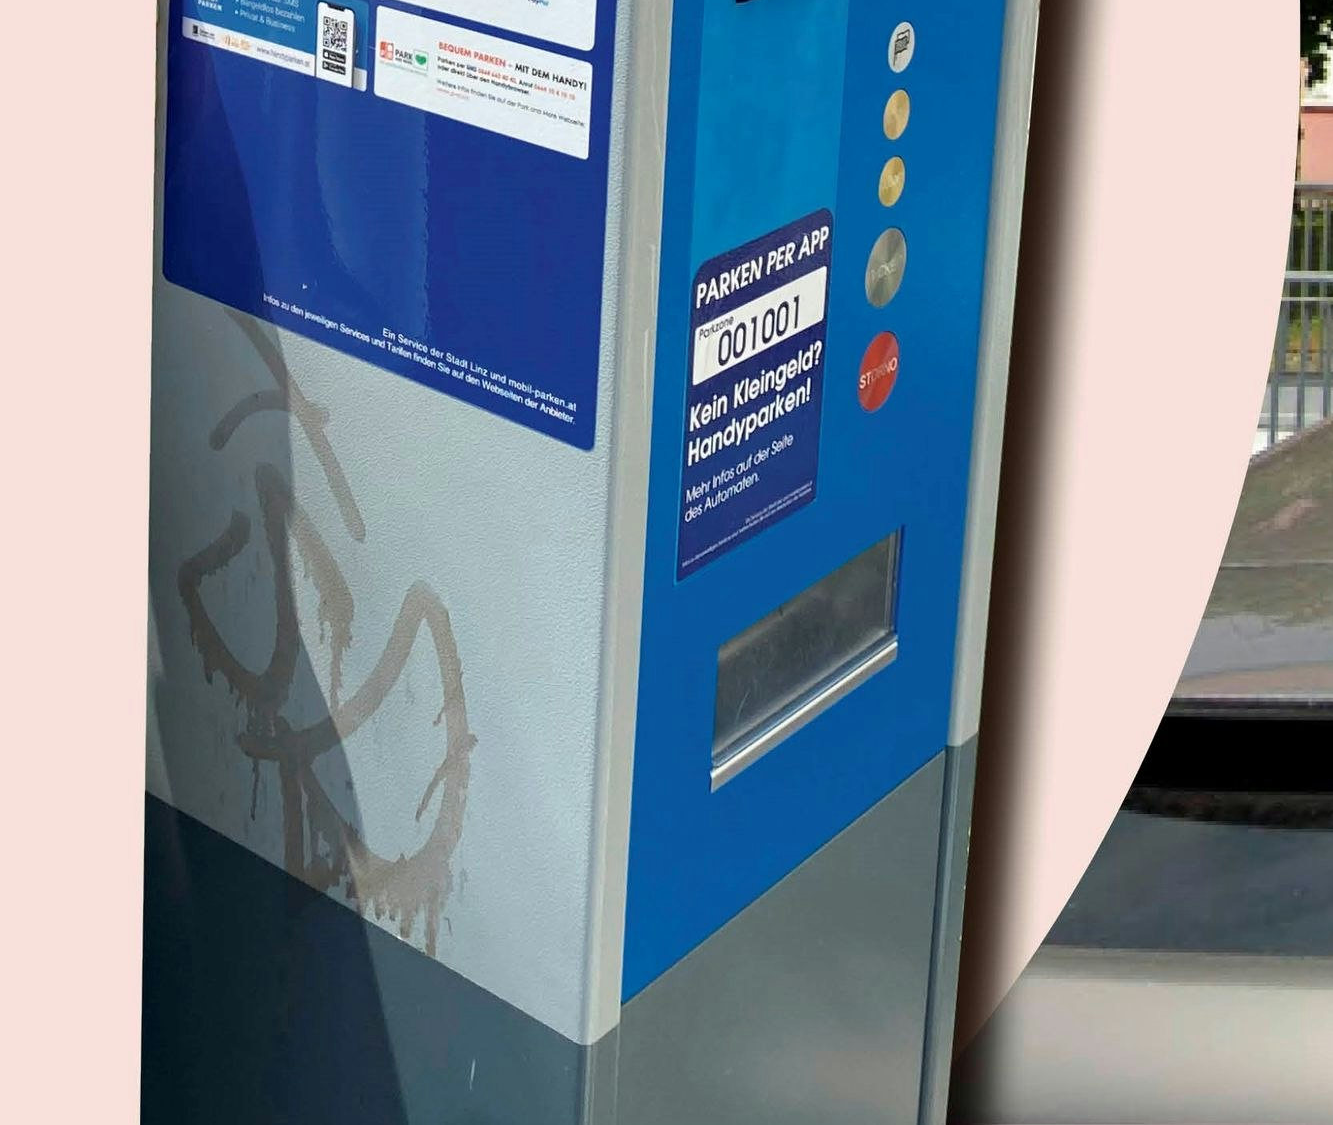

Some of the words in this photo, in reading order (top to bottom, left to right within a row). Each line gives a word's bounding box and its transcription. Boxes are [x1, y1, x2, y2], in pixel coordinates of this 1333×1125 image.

[395, 48, 413, 60] PARK
[438, 41, 472, 58] BEQUEM
[474, 51, 506, 68] PARKEN
[514, 62, 530, 76] MIT
[532, 67, 550, 81] DEM
[695, 255, 763, 309] PARKEN
[766, 242, 796, 275] PER
[798, 225, 830, 261] APP
[263, 293, 280, 307] Infos
[281, 301, 289, 311] zu
[290, 304, 304, 317] den
[304, 309, 339, 331] jeweiligen
[340, 323, 370, 343] Services
[371, 337, 386, 349] und
[387, 342, 412, 359] Tarifen
[413, 351, 436, 369] finden
[438, 361, 451, 375] Sie
[452, 368, 465, 380] auf
[466, 374, 481, 387] den
[482, 379, 523, 404] Webseiten
[525, 397, 539, 410] der
[540, 403, 576, 425] Anbieter.
[698, 315, 734, 341] Parkzone
[717, 294, 802, 367] 001001
[383, 328, 396, 340] Ein
[398, 334, 428, 353] Service
[430, 346, 444, 359] der
[446, 353, 468, 369] Stadt
[470, 361, 488, 377] Linz
[490, 371, 507, 385] und
[508, 378, 576, 412] mobil-parken.at
[690, 393, 728, 432] Kein
[733, 340, 823, 410] Kleingeld?
[687, 377, 812, 467] Handyparken!
[684, 498, 703, 524] des
[703, 472, 761, 514] Automaten.
[685, 479, 711, 504] Mehr
[712, 467, 735, 492] Infos
[736, 458, 753, 477] auf
[753, 448, 770, 466] der
[771, 433, 795, 458] Seite
